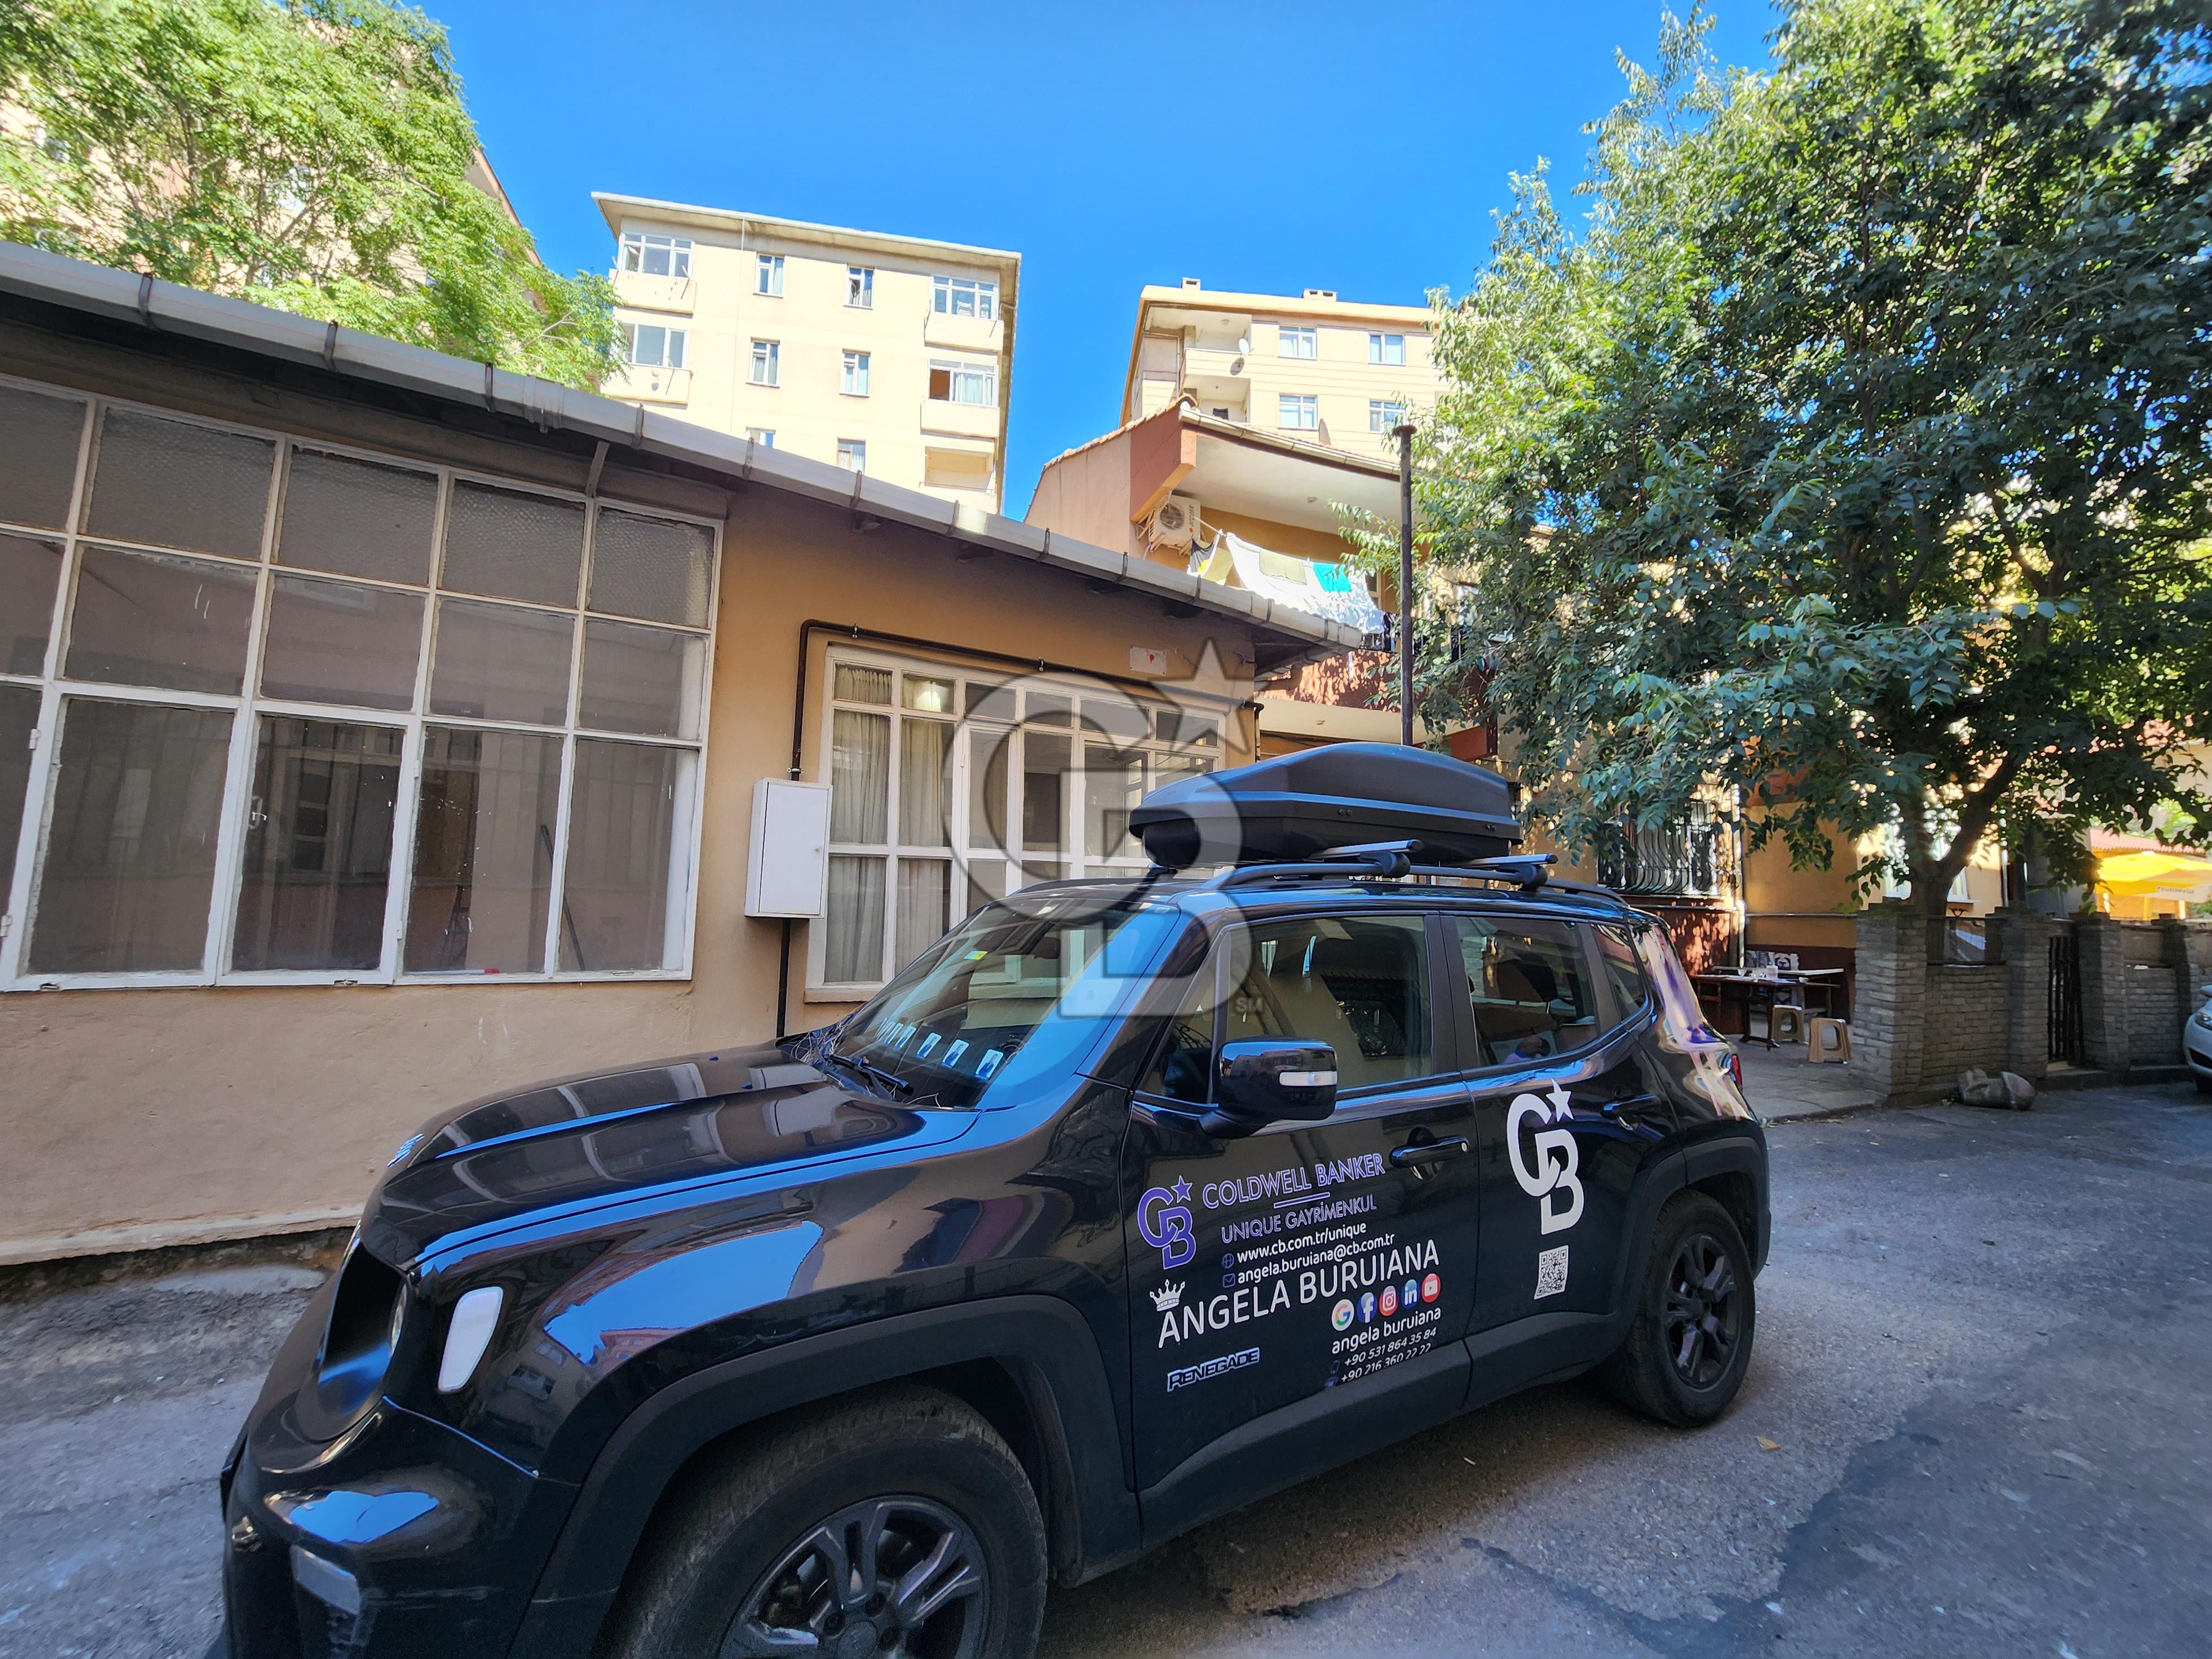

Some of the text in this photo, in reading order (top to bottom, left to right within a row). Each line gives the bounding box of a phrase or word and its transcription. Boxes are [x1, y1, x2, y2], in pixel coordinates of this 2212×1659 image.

[1202, 1153, 1386, 1209] COLDWELL BANKER
[1221, 1193, 1377, 1244] UNIQUE GAYRİMENKUL
[1237, 1222, 1367, 1264] www.cb.com.tr/unique
[1238, 1233, 1395, 1284] angela.buruiana@cb.com.tr
[1158, 1239, 1439, 1348] ANGELA BURUIANA
[1332, 1307, 1441, 1354] angela buruiana
[1344, 1327, 1437, 1366] +90 531 864 35 84
[1167, 1347, 1260, 1392] RENEGADE
[1341, 1368, 1363, 1383] +90
[1364, 1359, 1383, 1375] 216
[1384, 1352, 1404, 1368] 360
